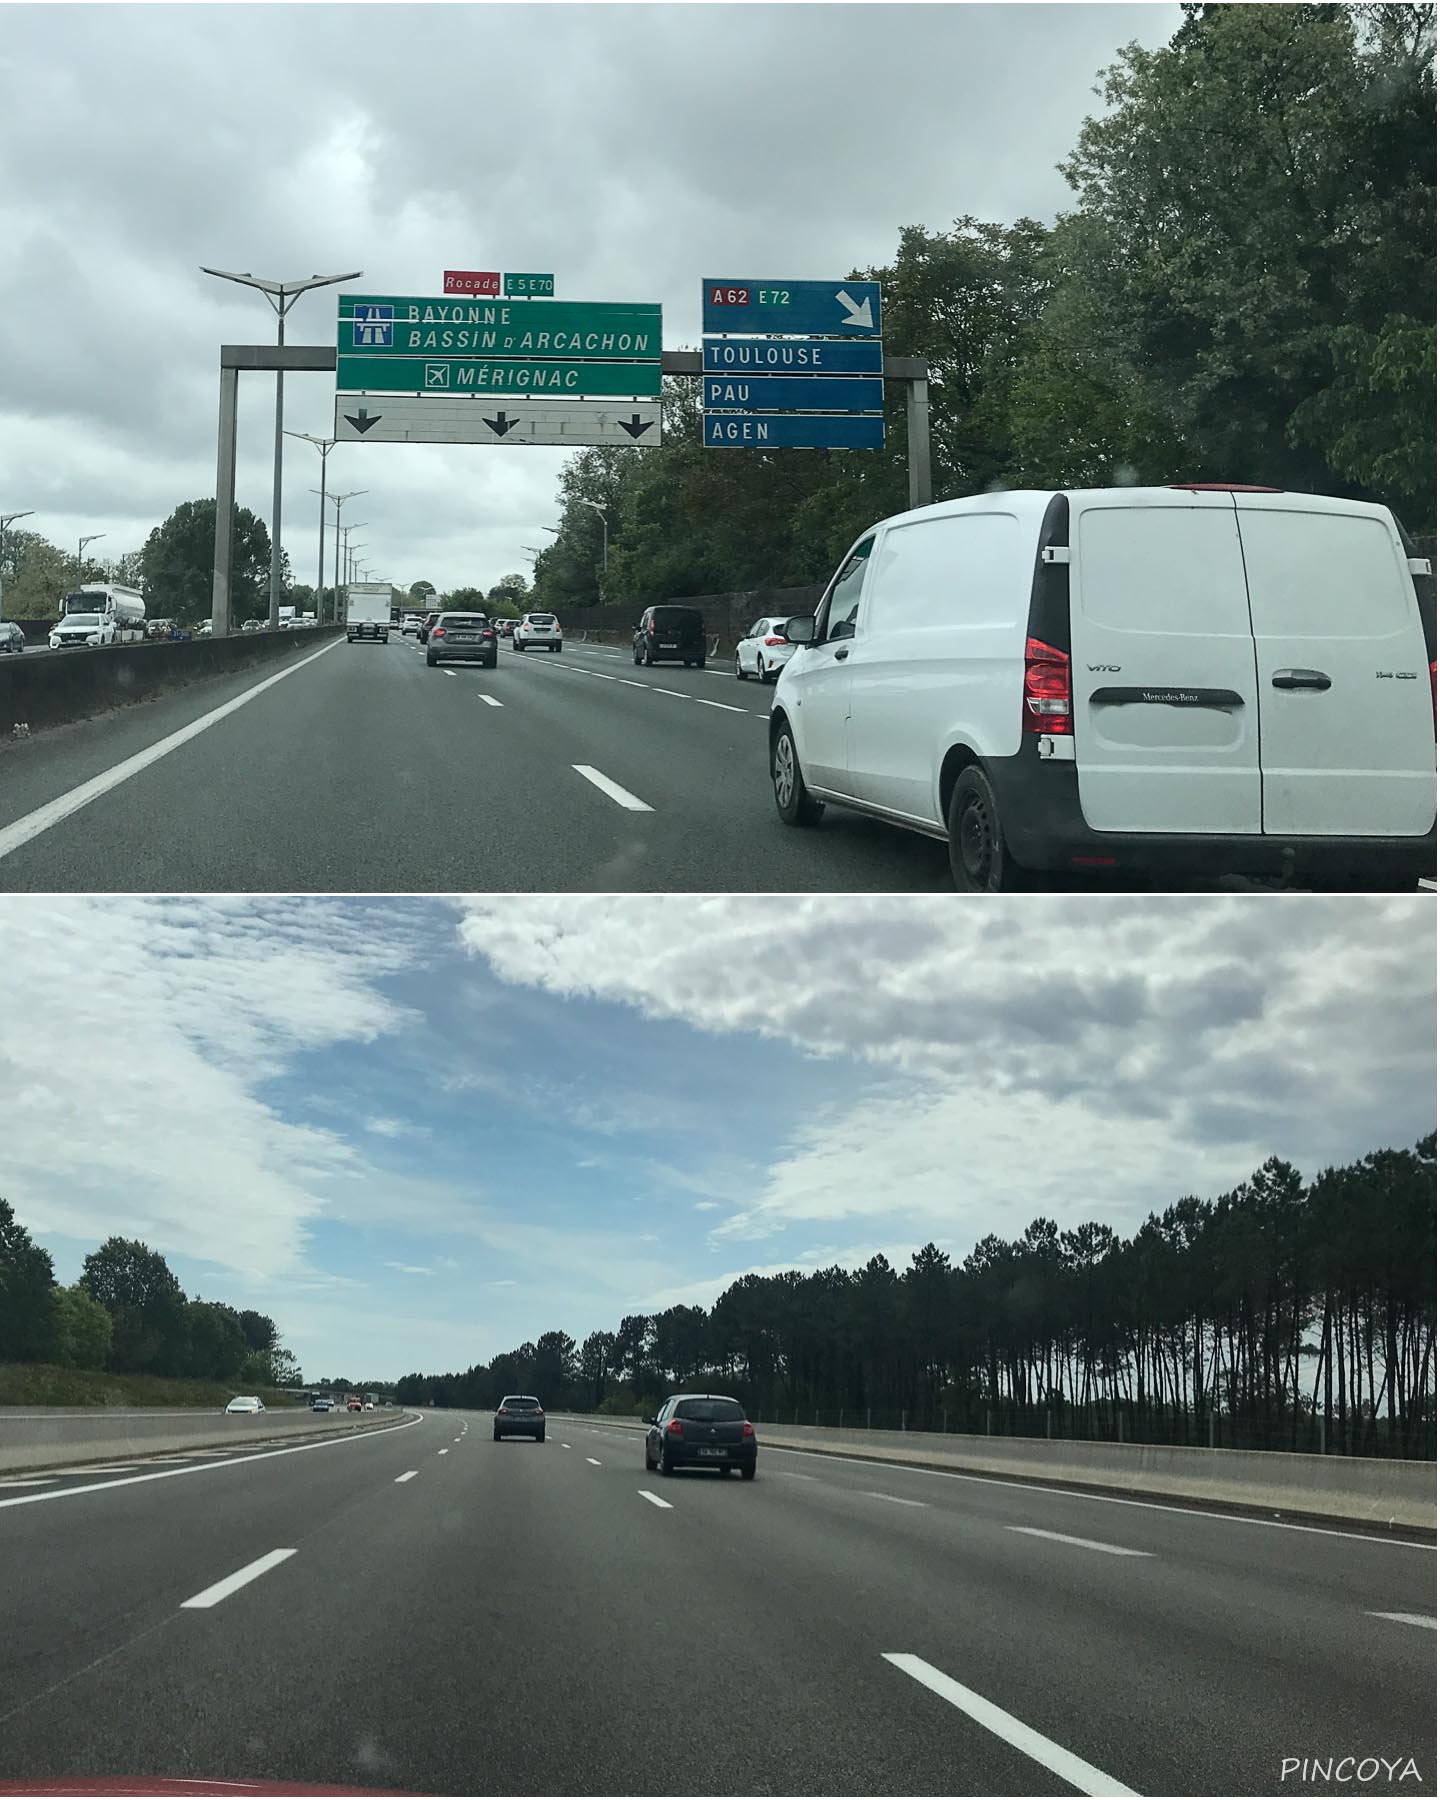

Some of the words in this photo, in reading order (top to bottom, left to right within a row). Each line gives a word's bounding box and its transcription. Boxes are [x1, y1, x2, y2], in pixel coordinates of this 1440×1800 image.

[445, 276, 499, 289] Rocade
[713, 289, 723, 303] A
[727, 290, 748, 304] 62
[759, 290, 767, 304] E
[771, 291, 790, 305] 72
[408, 305, 511, 325] BAYONNE
[408, 330, 497, 348] BASSIN
[711, 347, 823, 365] TOULOUSE
[456, 364, 579, 387] MÉRIGNAC
[711, 384, 749, 401] PAU
[712, 423, 768, 440] AGEN
[1142, 692, 1199, 702] Mercedes-Benz
